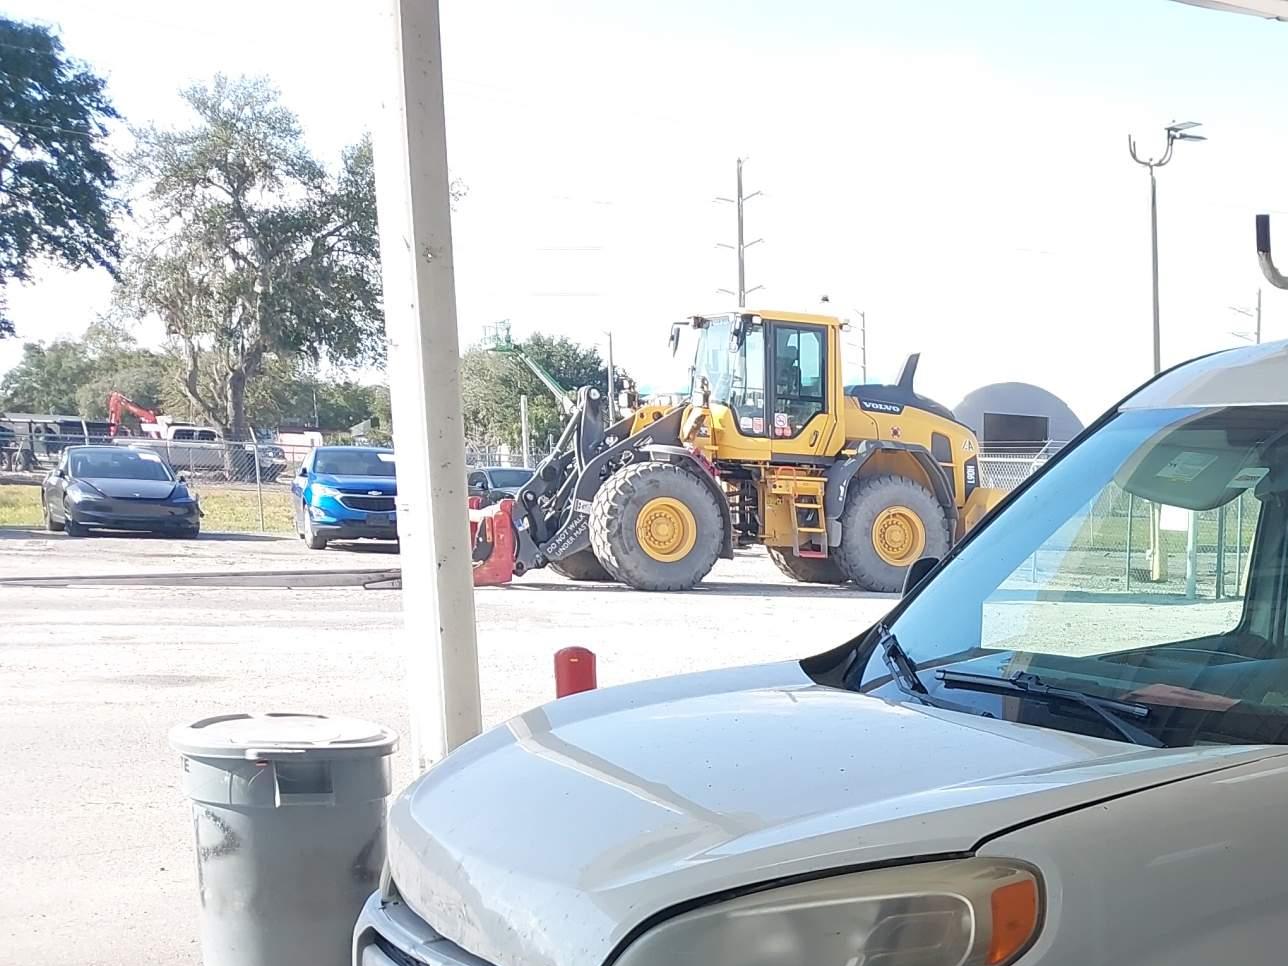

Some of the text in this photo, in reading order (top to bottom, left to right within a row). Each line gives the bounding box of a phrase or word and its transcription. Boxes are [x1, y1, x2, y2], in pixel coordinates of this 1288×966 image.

[862, 401, 900, 412] VOLVO
[546, 514, 586, 554] DO NOT WALK
[555, 536, 576, 556] UNDER
[573, 521, 588, 538] MAST
